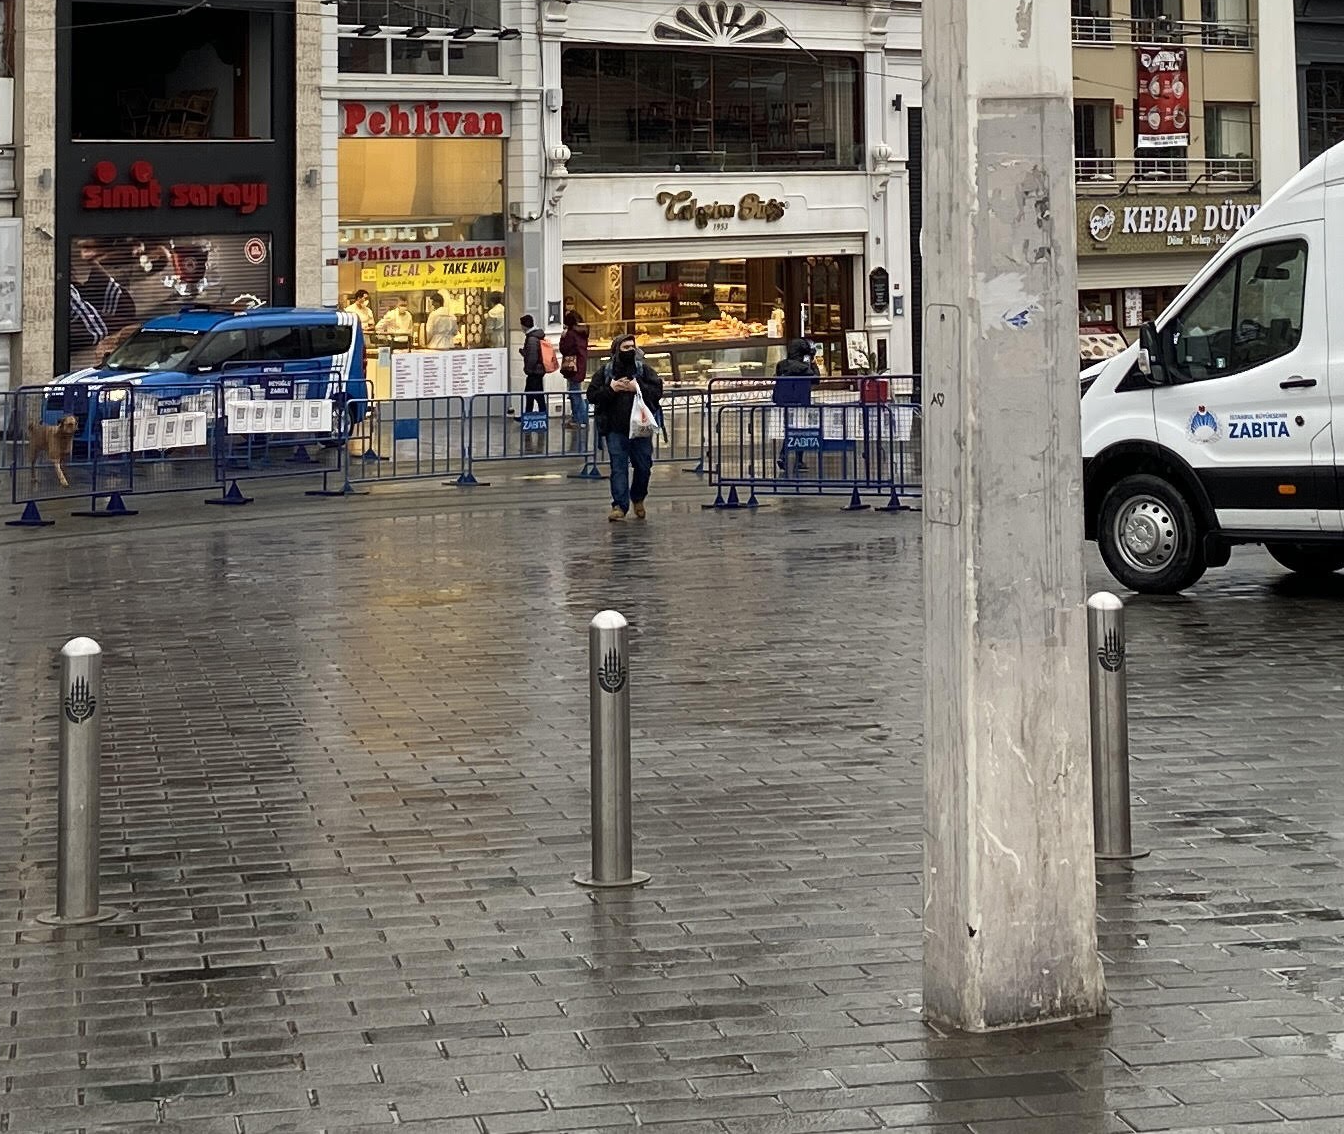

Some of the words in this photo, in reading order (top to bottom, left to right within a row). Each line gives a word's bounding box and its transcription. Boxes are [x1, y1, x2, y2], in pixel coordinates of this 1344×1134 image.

[343, 99, 504, 136] Pehlivan
[82, 160, 162, 208] simit
[169, 183, 269, 214] sarayı
[712, 223, 729, 231] 1953
[1121, 205, 1198, 234] KEBAP
[346, 246, 421, 262] Pehlivan
[425, 245, 505, 259] Lokantası
[383, 264, 420, 277] GEL-AL
[443, 263, 468, 275] TAKE
[470, 261, 500, 274] AWAY
[522, 420, 547, 430] ZABITA
[1228, 421, 1290, 439] ZABITA
[787, 436, 820, 448] ZABITA
